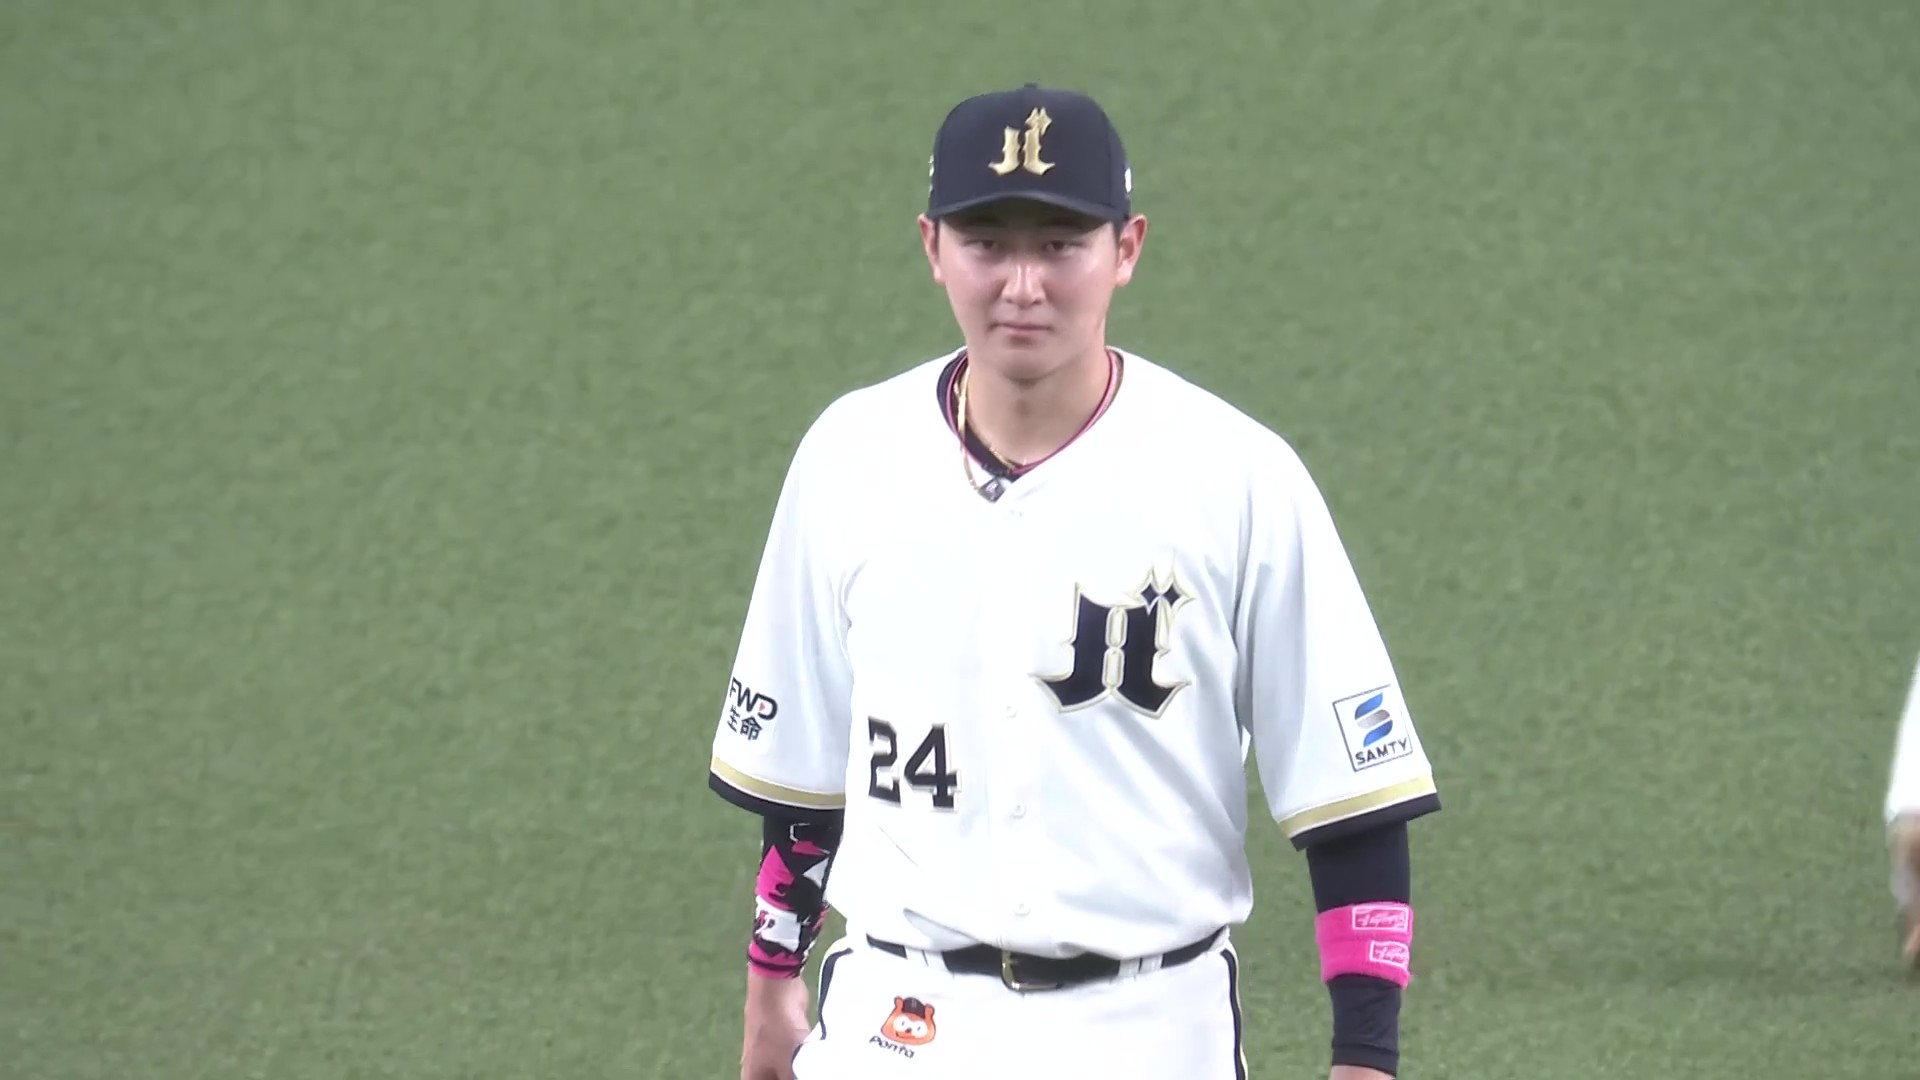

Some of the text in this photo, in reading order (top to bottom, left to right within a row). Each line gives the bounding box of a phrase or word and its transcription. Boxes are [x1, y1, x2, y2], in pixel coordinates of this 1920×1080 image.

[729, 676, 778, 721] FWD
[726, 704, 763, 741] 生命
[868, 716, 961, 813] 24
[1354, 737, 1408, 766] SAMTY
